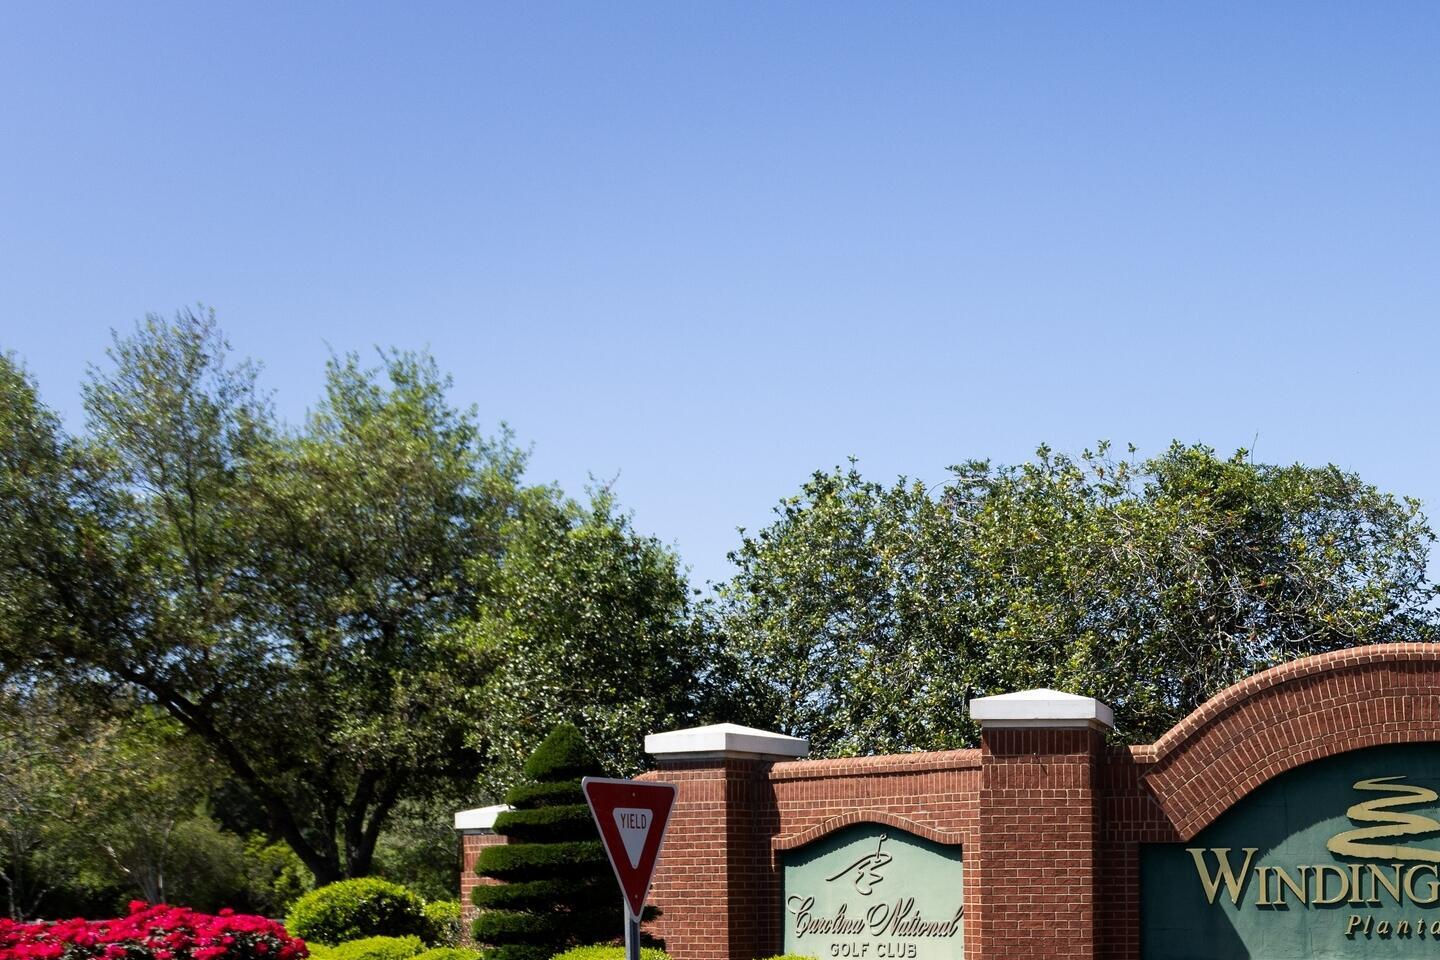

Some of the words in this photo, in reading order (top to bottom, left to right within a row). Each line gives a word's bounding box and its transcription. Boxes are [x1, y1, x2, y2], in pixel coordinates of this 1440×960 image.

[620, 813, 647, 829] YIELD
[787, 895, 865, 939] Carolina
[866, 897, 965, 938] National
[830, 942, 870, 958] GOLF
[877, 943, 917, 958] CLUB
